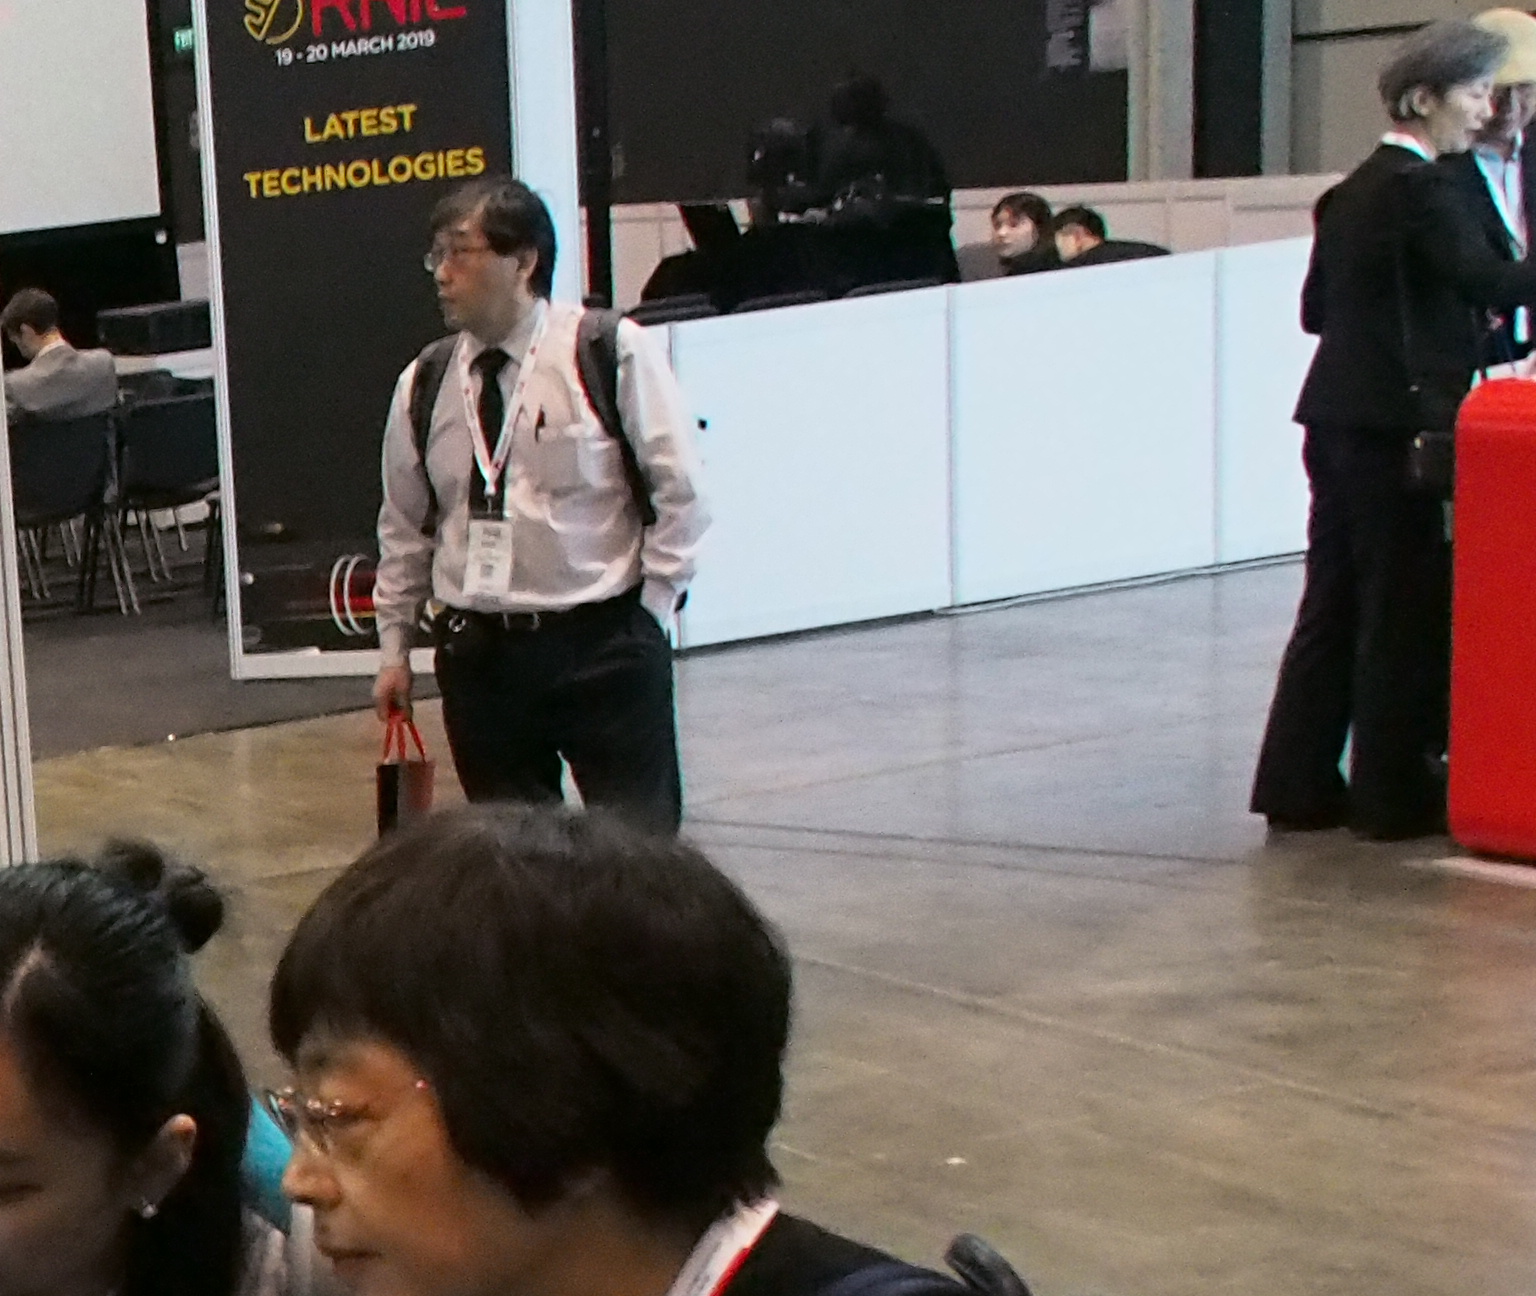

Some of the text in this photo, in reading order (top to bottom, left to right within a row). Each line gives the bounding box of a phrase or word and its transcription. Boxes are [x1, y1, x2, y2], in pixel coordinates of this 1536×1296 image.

[275, 48, 294, 66] 19
[306, 44, 328, 63] 20
[331, 33, 393, 58] MARCH
[397, 28, 436, 50] 2019
[303, 102, 418, 144] LATEST
[243, 145, 487, 198] TECHNOLOGIES
